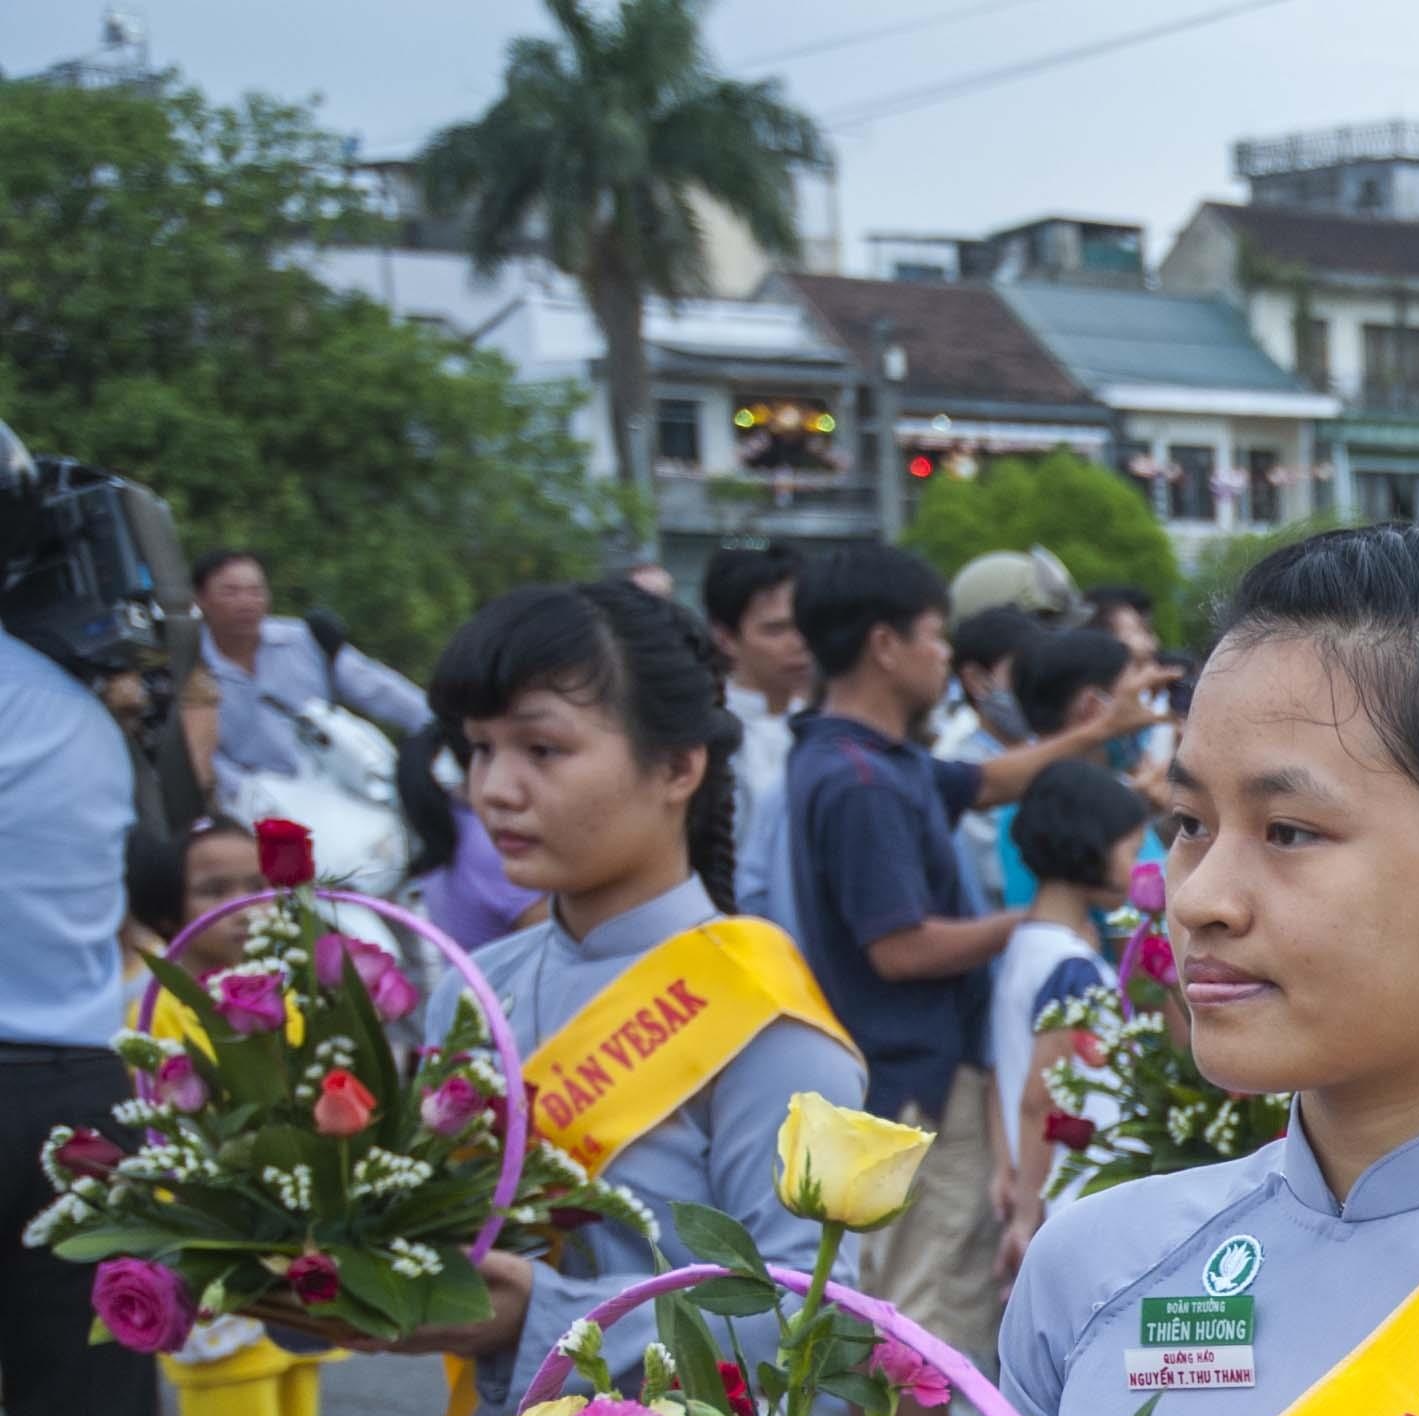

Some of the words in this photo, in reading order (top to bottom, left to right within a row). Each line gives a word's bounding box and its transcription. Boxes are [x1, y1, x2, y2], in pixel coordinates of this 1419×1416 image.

[600, 978, 708, 1071] VESAK
[1146, 1317, 1191, 1342] THIÊN
[1195, 1318, 1246, 1341] HƯƠNG
[1214, 1368, 1252, 1384] THANH
